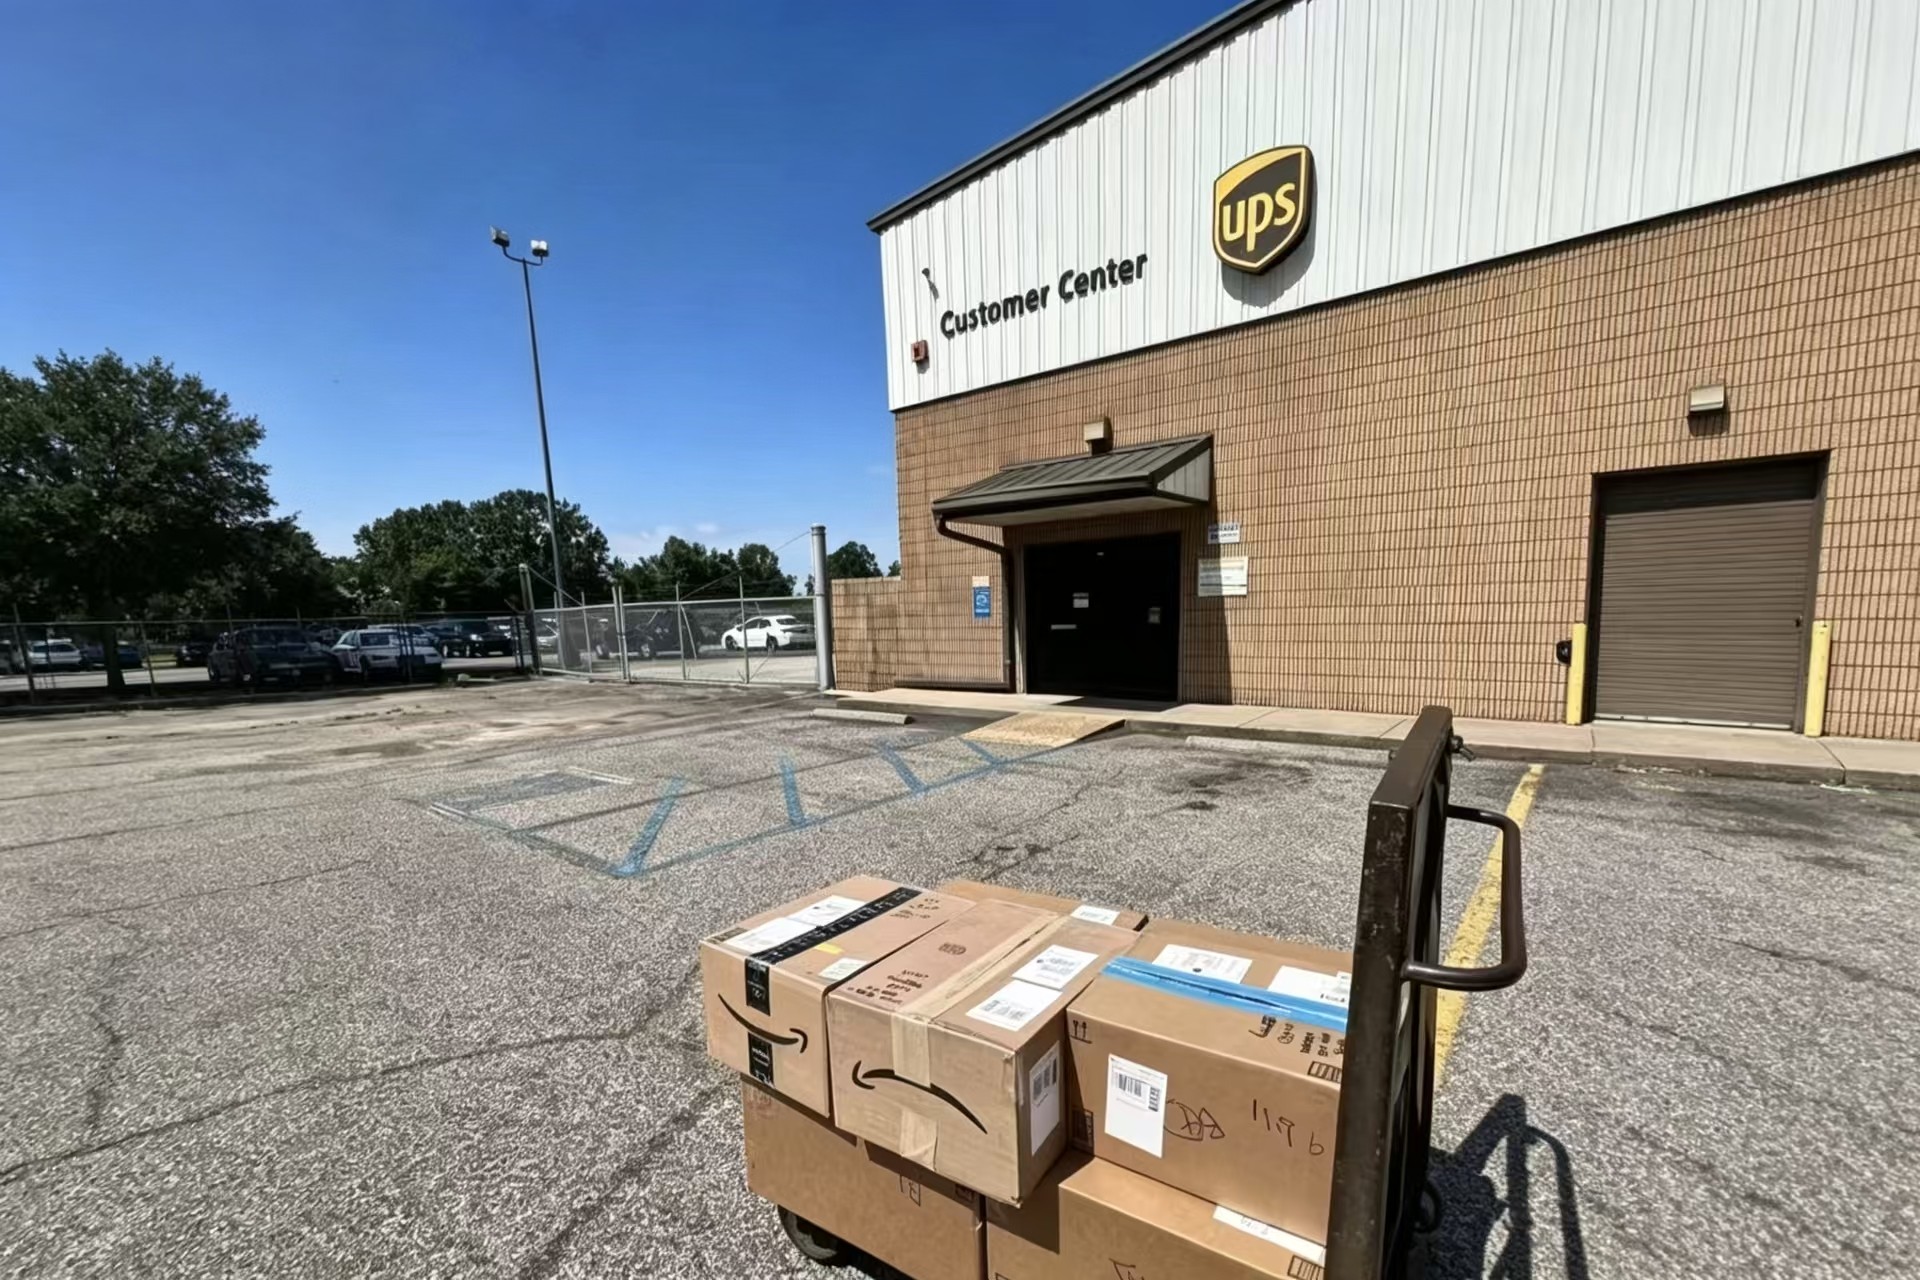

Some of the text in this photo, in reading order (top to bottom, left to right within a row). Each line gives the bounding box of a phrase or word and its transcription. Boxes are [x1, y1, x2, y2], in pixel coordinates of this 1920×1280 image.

[1222, 182, 1297, 253] ups
[940, 252, 1148, 340] Customer Center
